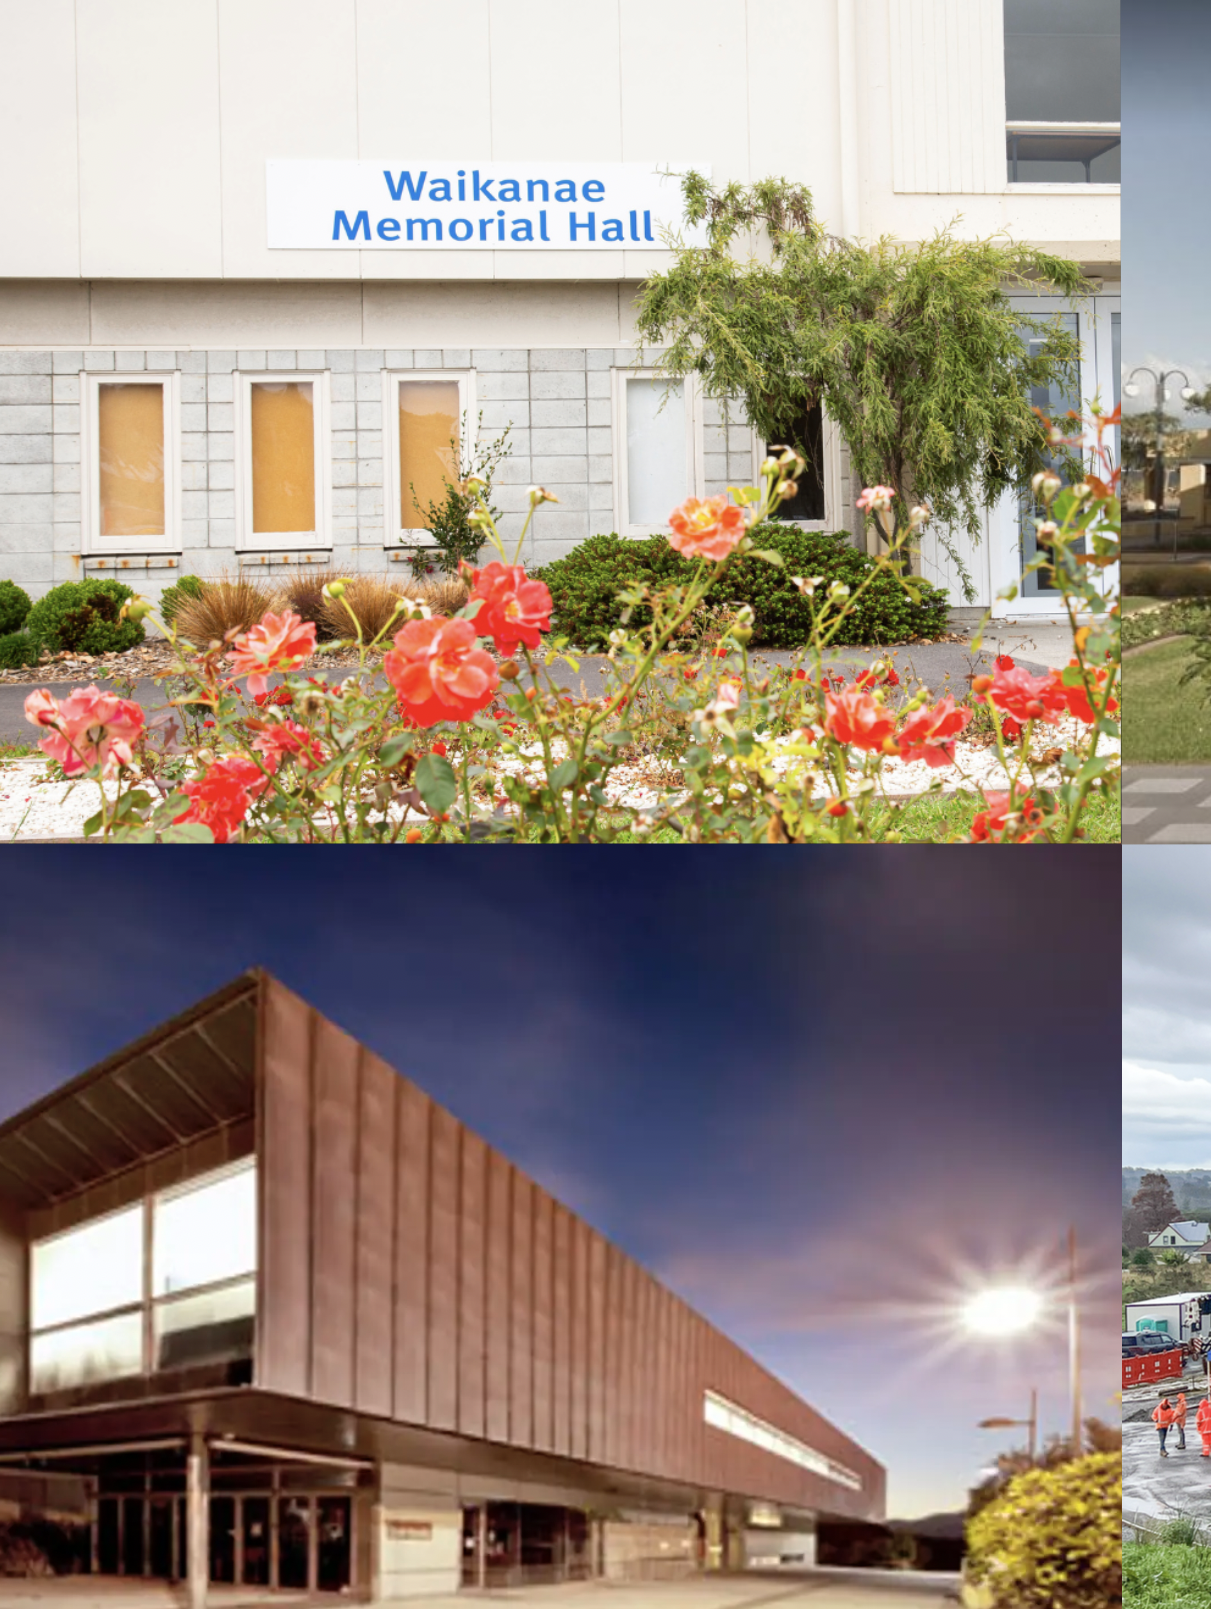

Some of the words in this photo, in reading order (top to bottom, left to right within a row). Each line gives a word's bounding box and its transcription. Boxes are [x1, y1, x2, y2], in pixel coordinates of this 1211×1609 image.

[383, 169, 606, 203] Waikanae
[332, 209, 550, 242] Memorial
[569, 209, 655, 242] Hall
